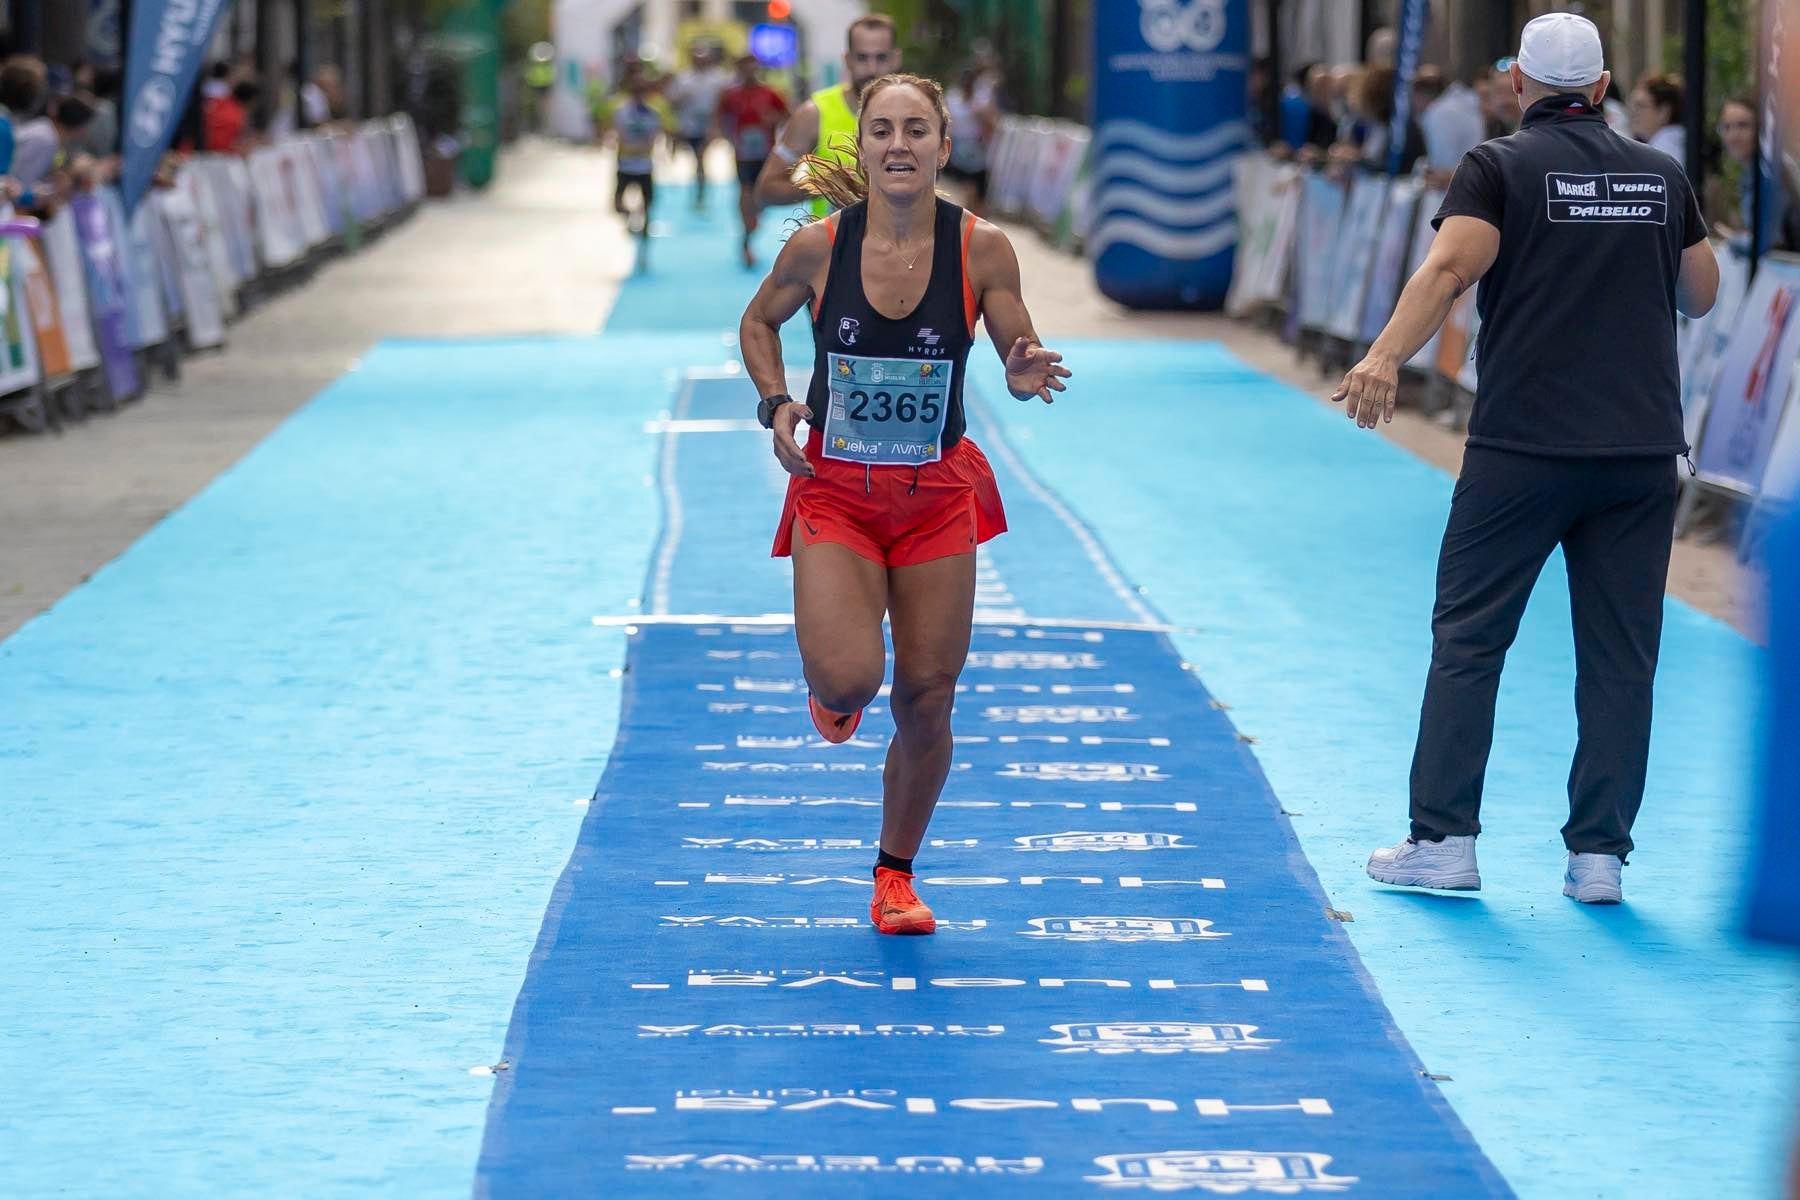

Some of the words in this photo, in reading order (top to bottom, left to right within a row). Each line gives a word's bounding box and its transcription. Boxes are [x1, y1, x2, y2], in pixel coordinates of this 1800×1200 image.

[1555, 178, 1596, 197] MARKER
[1568, 205, 1652, 217] DALBELLO
[908, 346, 945, 356] HYROX
[849, 390, 940, 424] 2365
[681, 838, 979, 847] HELVA
[704, 875, 1226, 888] Hueva
[658, 915, 988, 927] HELVA
[688, 975, 1268, 991] Huelva
[638, 1024, 1004, 1033] HUELVA
[675, 1087, 896, 1098] original
[625, 1154, 1043, 1168] HUELVA
